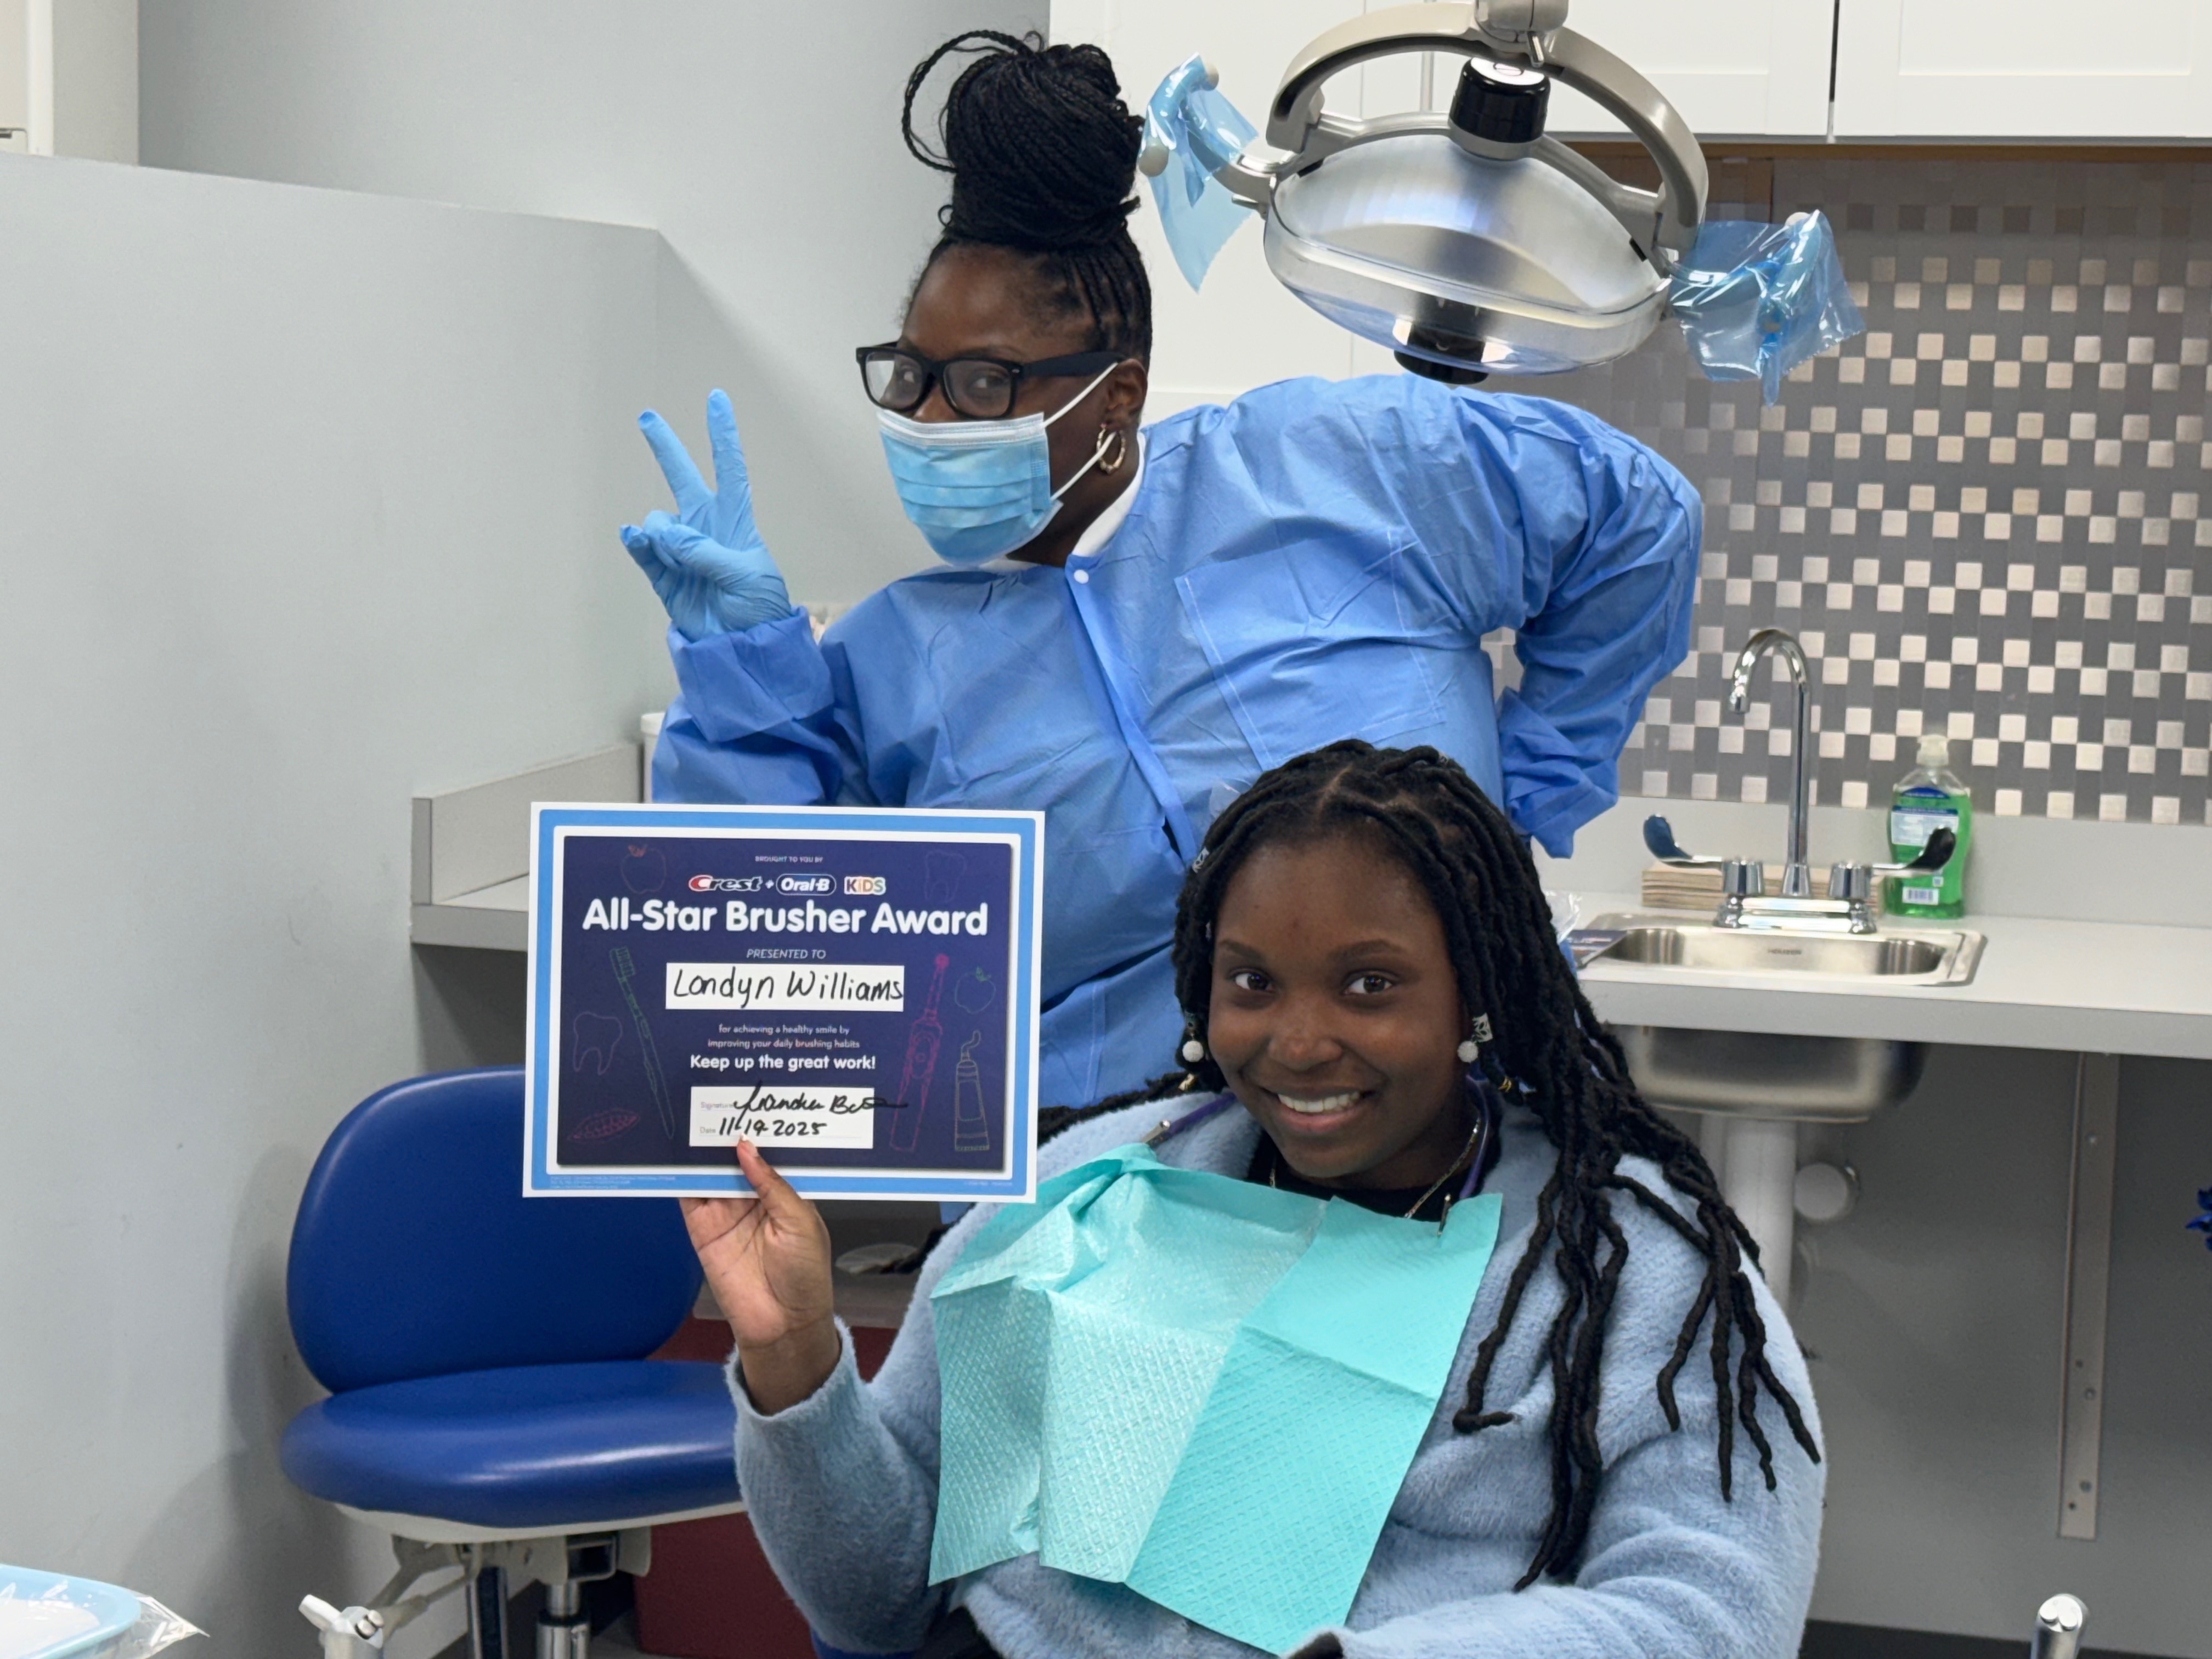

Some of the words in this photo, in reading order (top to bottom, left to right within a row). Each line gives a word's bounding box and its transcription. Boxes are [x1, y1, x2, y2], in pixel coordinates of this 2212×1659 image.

[689, 875, 763, 891] Crest
[781, 877, 830, 891] Oral-B
[582, 897, 717, 931] All-Star
[726, 899, 866, 933] Brusher
[871, 902, 988, 935] Award
[746, 949, 808, 959] PRESENTED
[811, 950, 826, 959] TO
[787, 970, 904, 1002] Williams
[719, 1023, 731, 1033] for
[733, 1024, 774, 1036] achieving
[782, 1024, 813, 1036] healthy
[815, 1025, 838, 1034] smile
[839, 1025, 850, 1035] by
[708, 1039, 751, 1049] improving
[752, 1041, 771, 1049] your
[773, 1039, 793, 1049] daily
[795, 1039, 833, 1050] brushing
[834, 1039, 860, 1048] habits
[690, 1054, 730, 1073] Keep
[735, 1057, 754, 1073] up
[758, 1054, 784, 1069] the
[788, 1054, 830, 1072] great
[833, 1054, 877, 1070] work!
